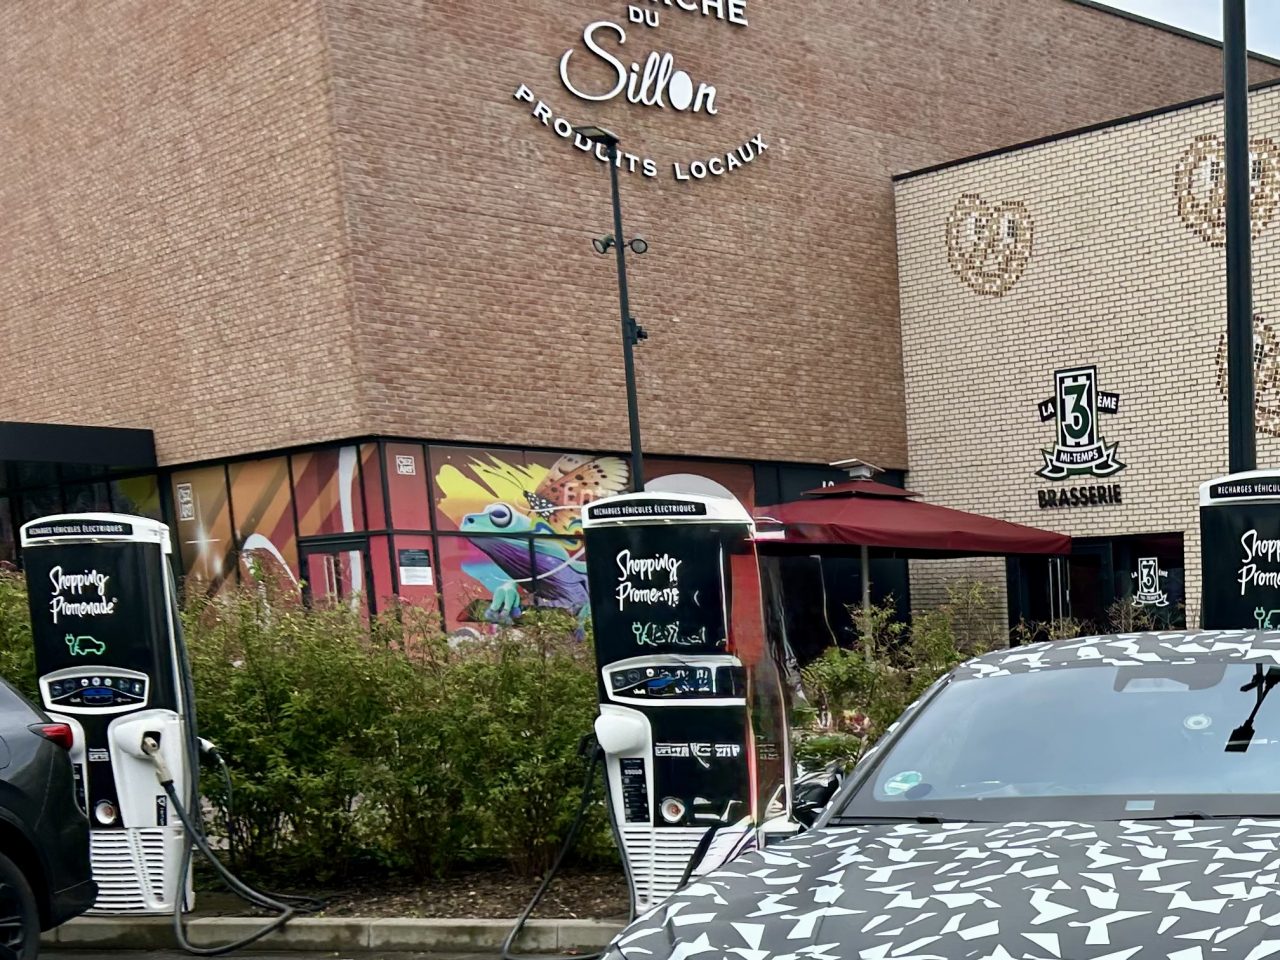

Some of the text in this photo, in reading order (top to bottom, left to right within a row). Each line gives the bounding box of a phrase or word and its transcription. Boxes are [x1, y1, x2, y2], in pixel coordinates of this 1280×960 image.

[628, 5, 660, 28] DU
[559, 21, 718, 115] Sillon
[513, 83, 769, 181] PRODUITS LOCAUX
[1041, 381, 1117, 441] LA 3 ÈME
[1059, 449, 1099, 463] MI-TEMPS
[1038, 484, 1123, 509] BRASSERIE
[1217, 484, 1252, 495] RECHARGES
[654, 504, 696, 513] ÉLECTRIQUES
[616, 549, 682, 582] Shopping
[49, 565, 110, 596] Shopping
[49, 595, 115, 624] Promenade
